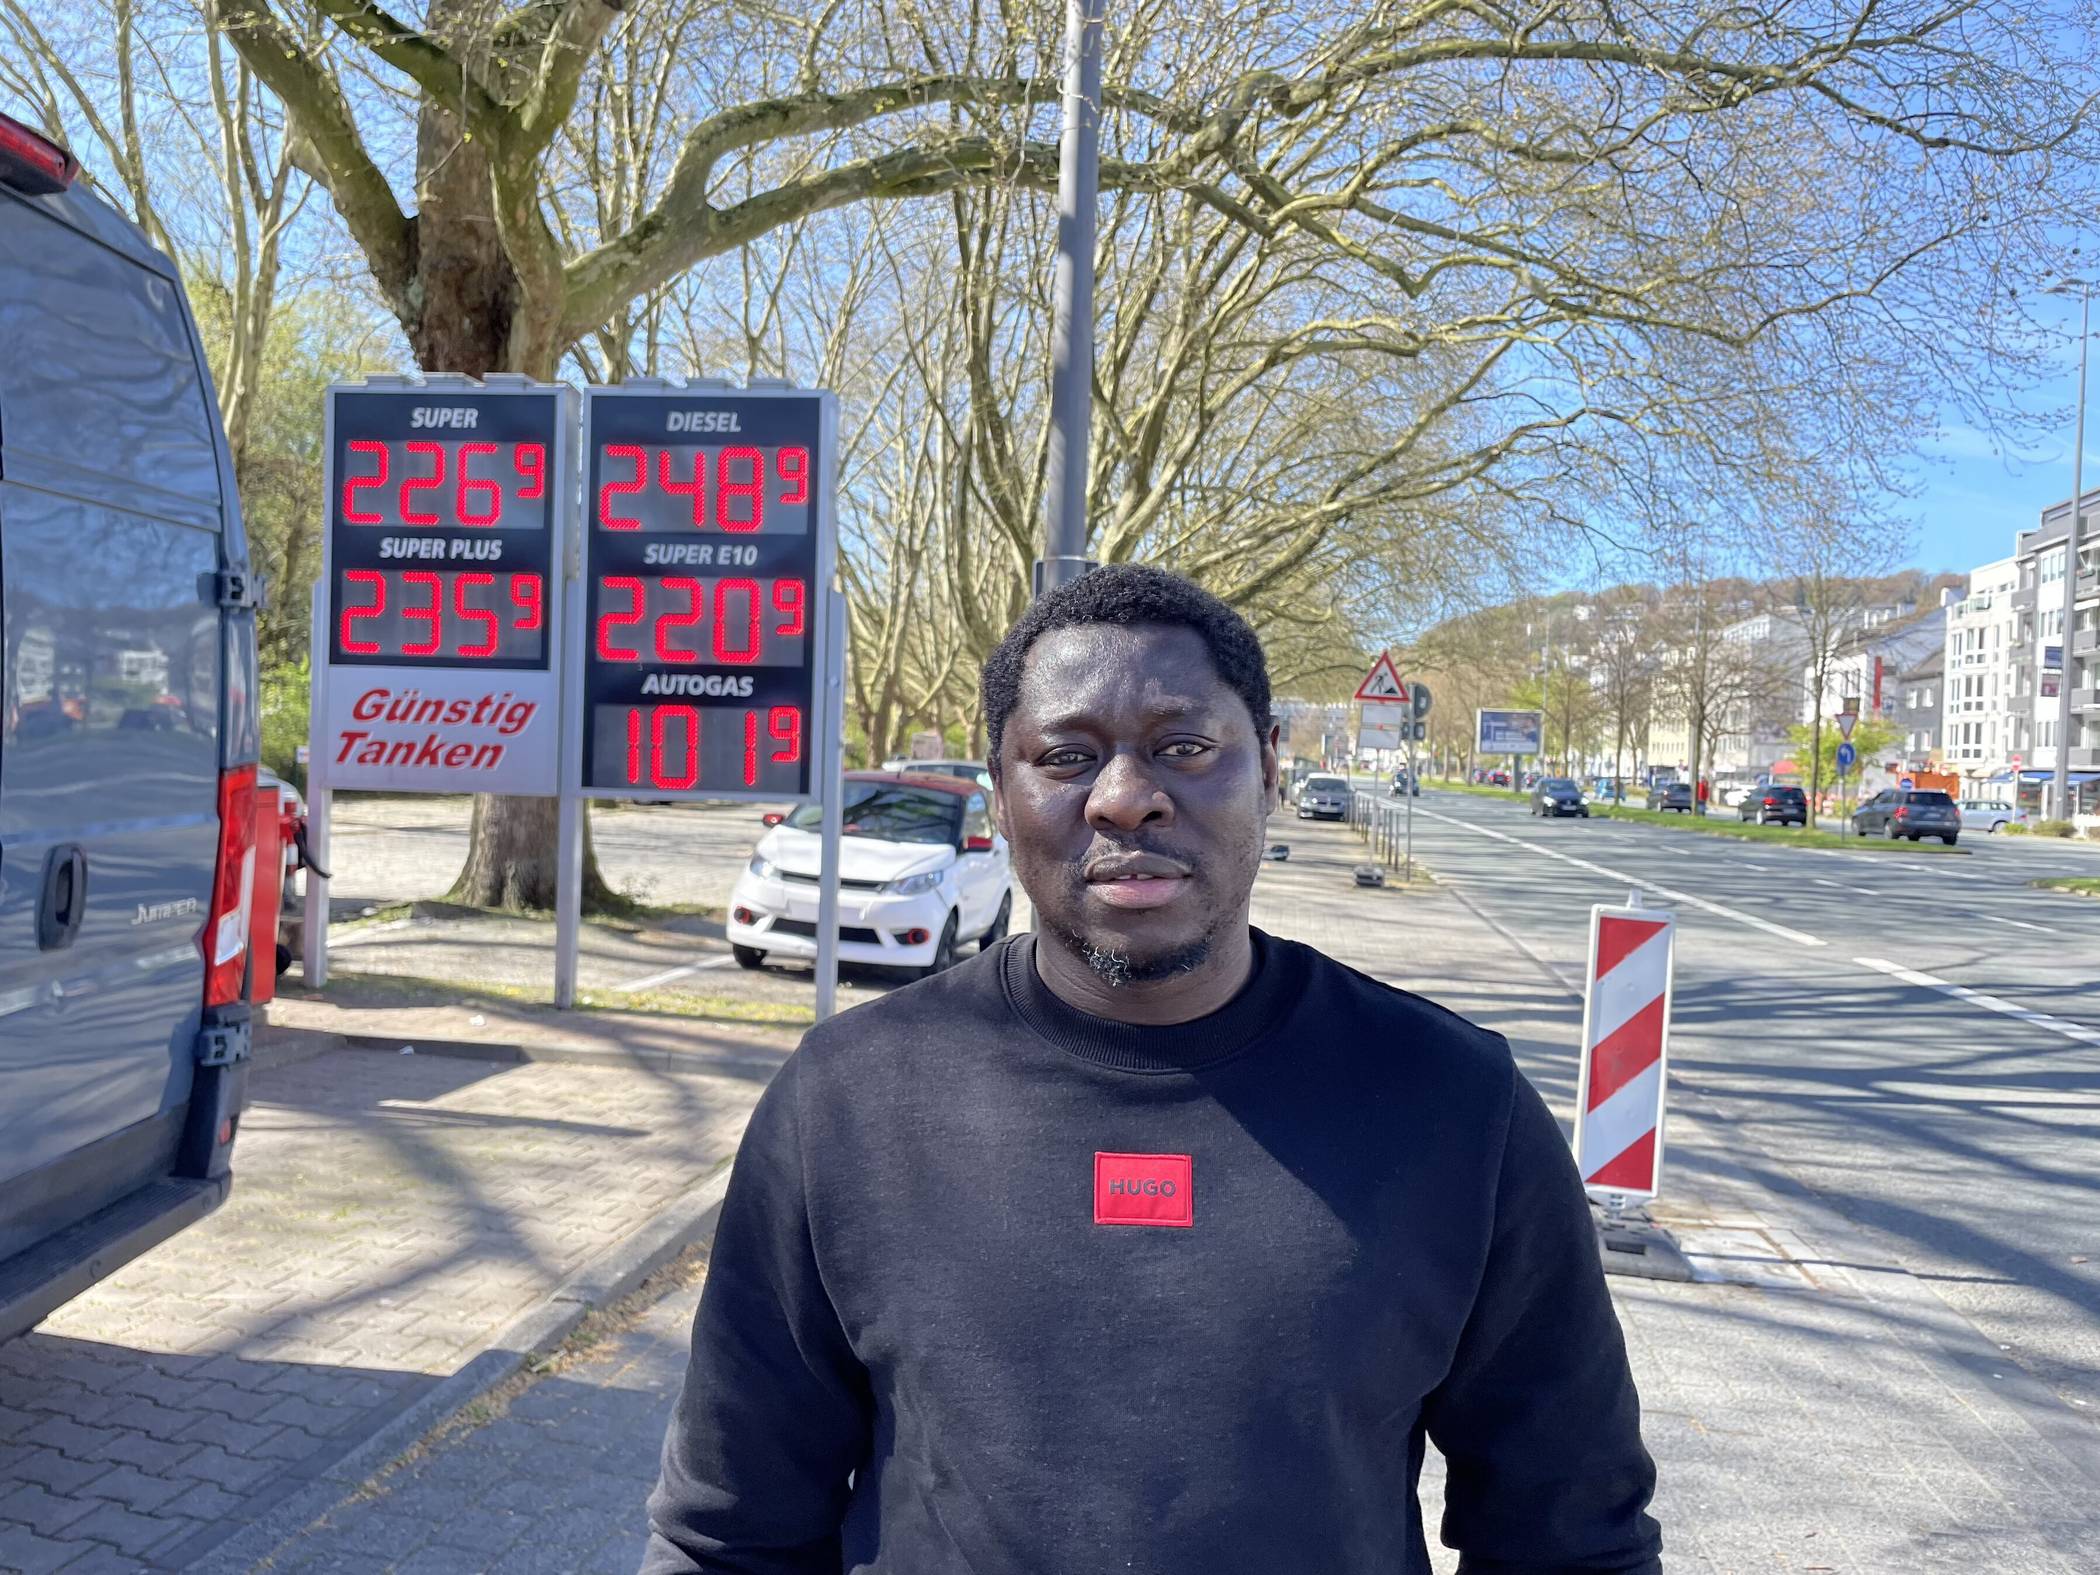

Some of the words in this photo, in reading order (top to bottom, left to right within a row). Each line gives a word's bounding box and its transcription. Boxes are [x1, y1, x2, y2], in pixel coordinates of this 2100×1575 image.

[410, 407, 479, 429] SUPER
[666, 411, 742, 433] DIESEL
[379, 537, 446, 560] SUPER
[448, 538, 503, 561] PLUS
[644, 544, 713, 565] SUPER
[717, 546, 758, 567] E10
[641, 674, 754, 697] AUTOGAS
[351, 687, 538, 738] Günstig
[334, 730, 504, 770] Tanken
[1109, 1178, 1176, 1198] HUGO
